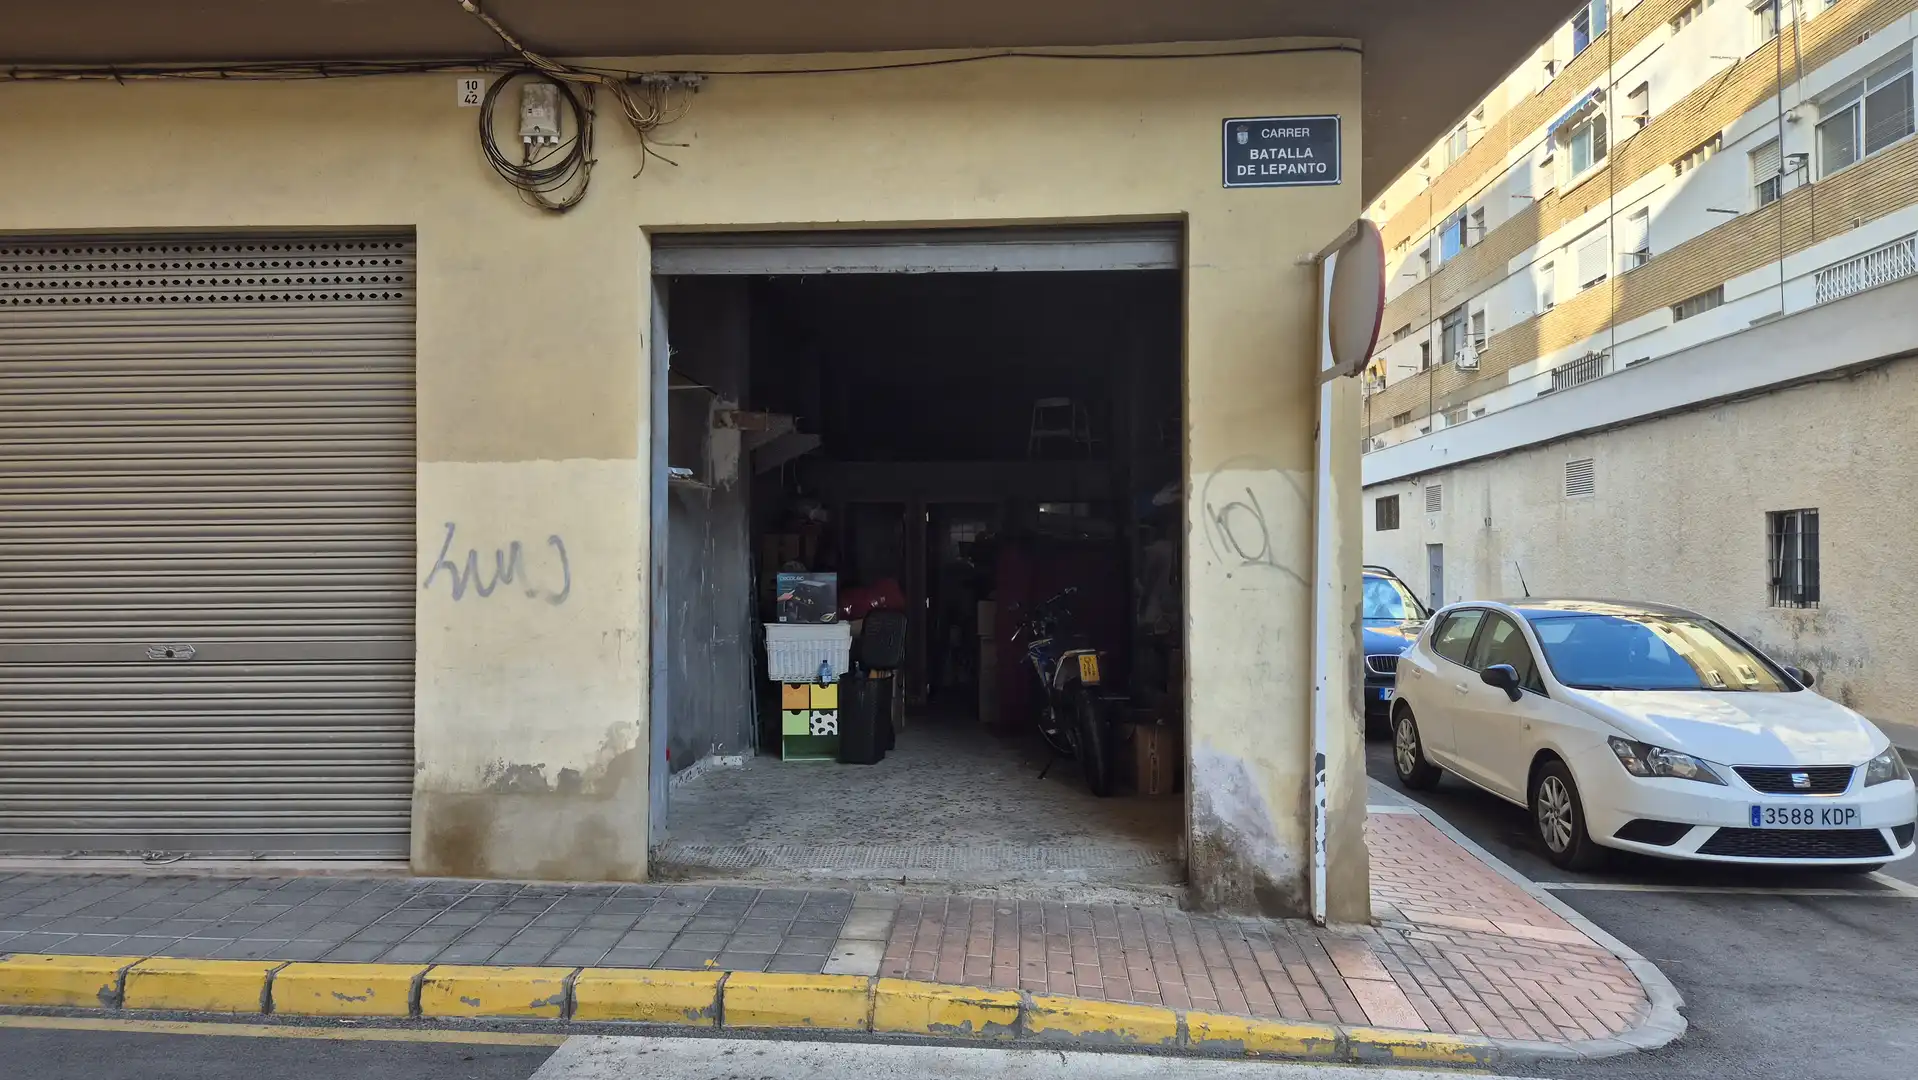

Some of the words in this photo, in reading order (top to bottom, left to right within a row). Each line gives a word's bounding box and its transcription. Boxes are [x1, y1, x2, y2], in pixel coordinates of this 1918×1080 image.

[465, 80, 478, 90] 10
[464, 94, 478, 104] 42
[1261, 127, 1310, 139] CARRER
[1250, 147, 1313, 160] BATALLA
[1237, 164, 1256, 176] DE
[1261, 162, 1327, 175] LEPANTO
[1765, 807, 1814, 825] 3588
[1821, 808, 1855, 825] KDP
